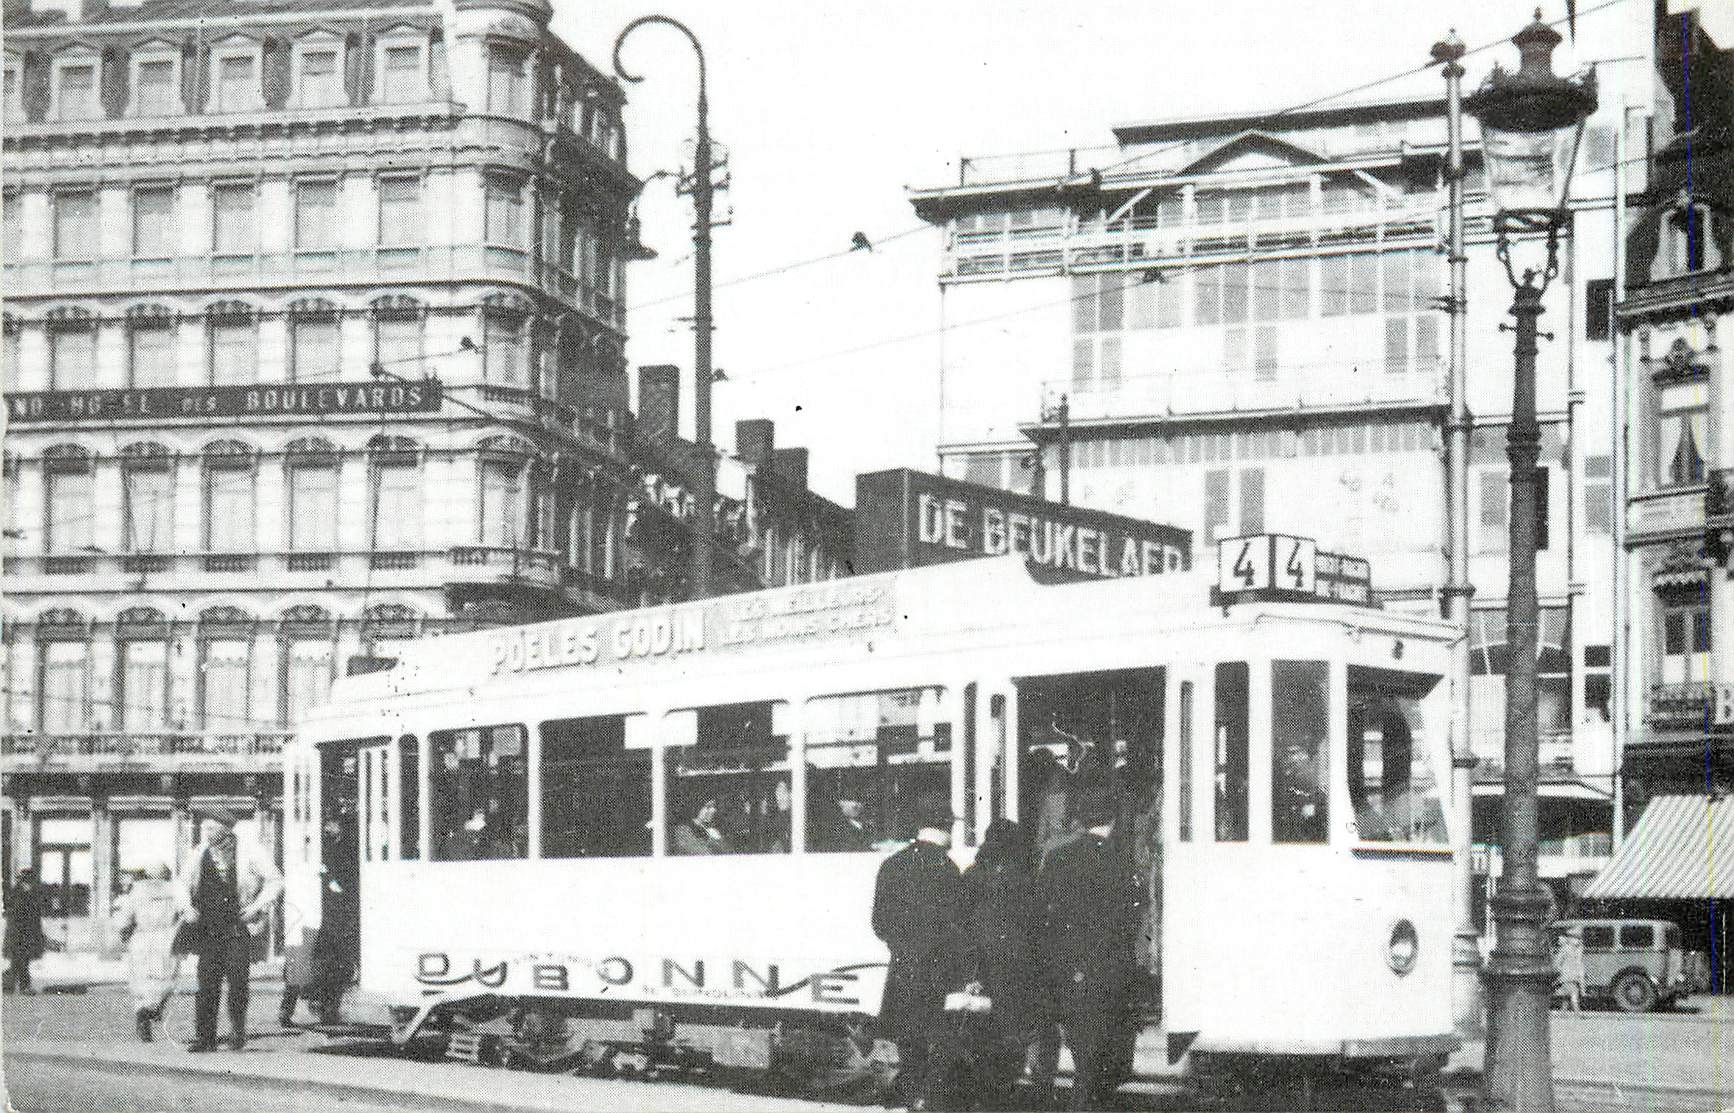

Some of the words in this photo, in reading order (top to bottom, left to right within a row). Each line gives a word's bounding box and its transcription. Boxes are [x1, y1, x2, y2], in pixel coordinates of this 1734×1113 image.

[246, 387, 422, 411] BOULEVARDS
[919, 494, 969, 549] DE
[1233, 541, 1255, 587] 4
[1286, 541, 1304, 588] 4
[489, 626, 600, 676] POELES
[611, 609, 708, 662] GODIN
